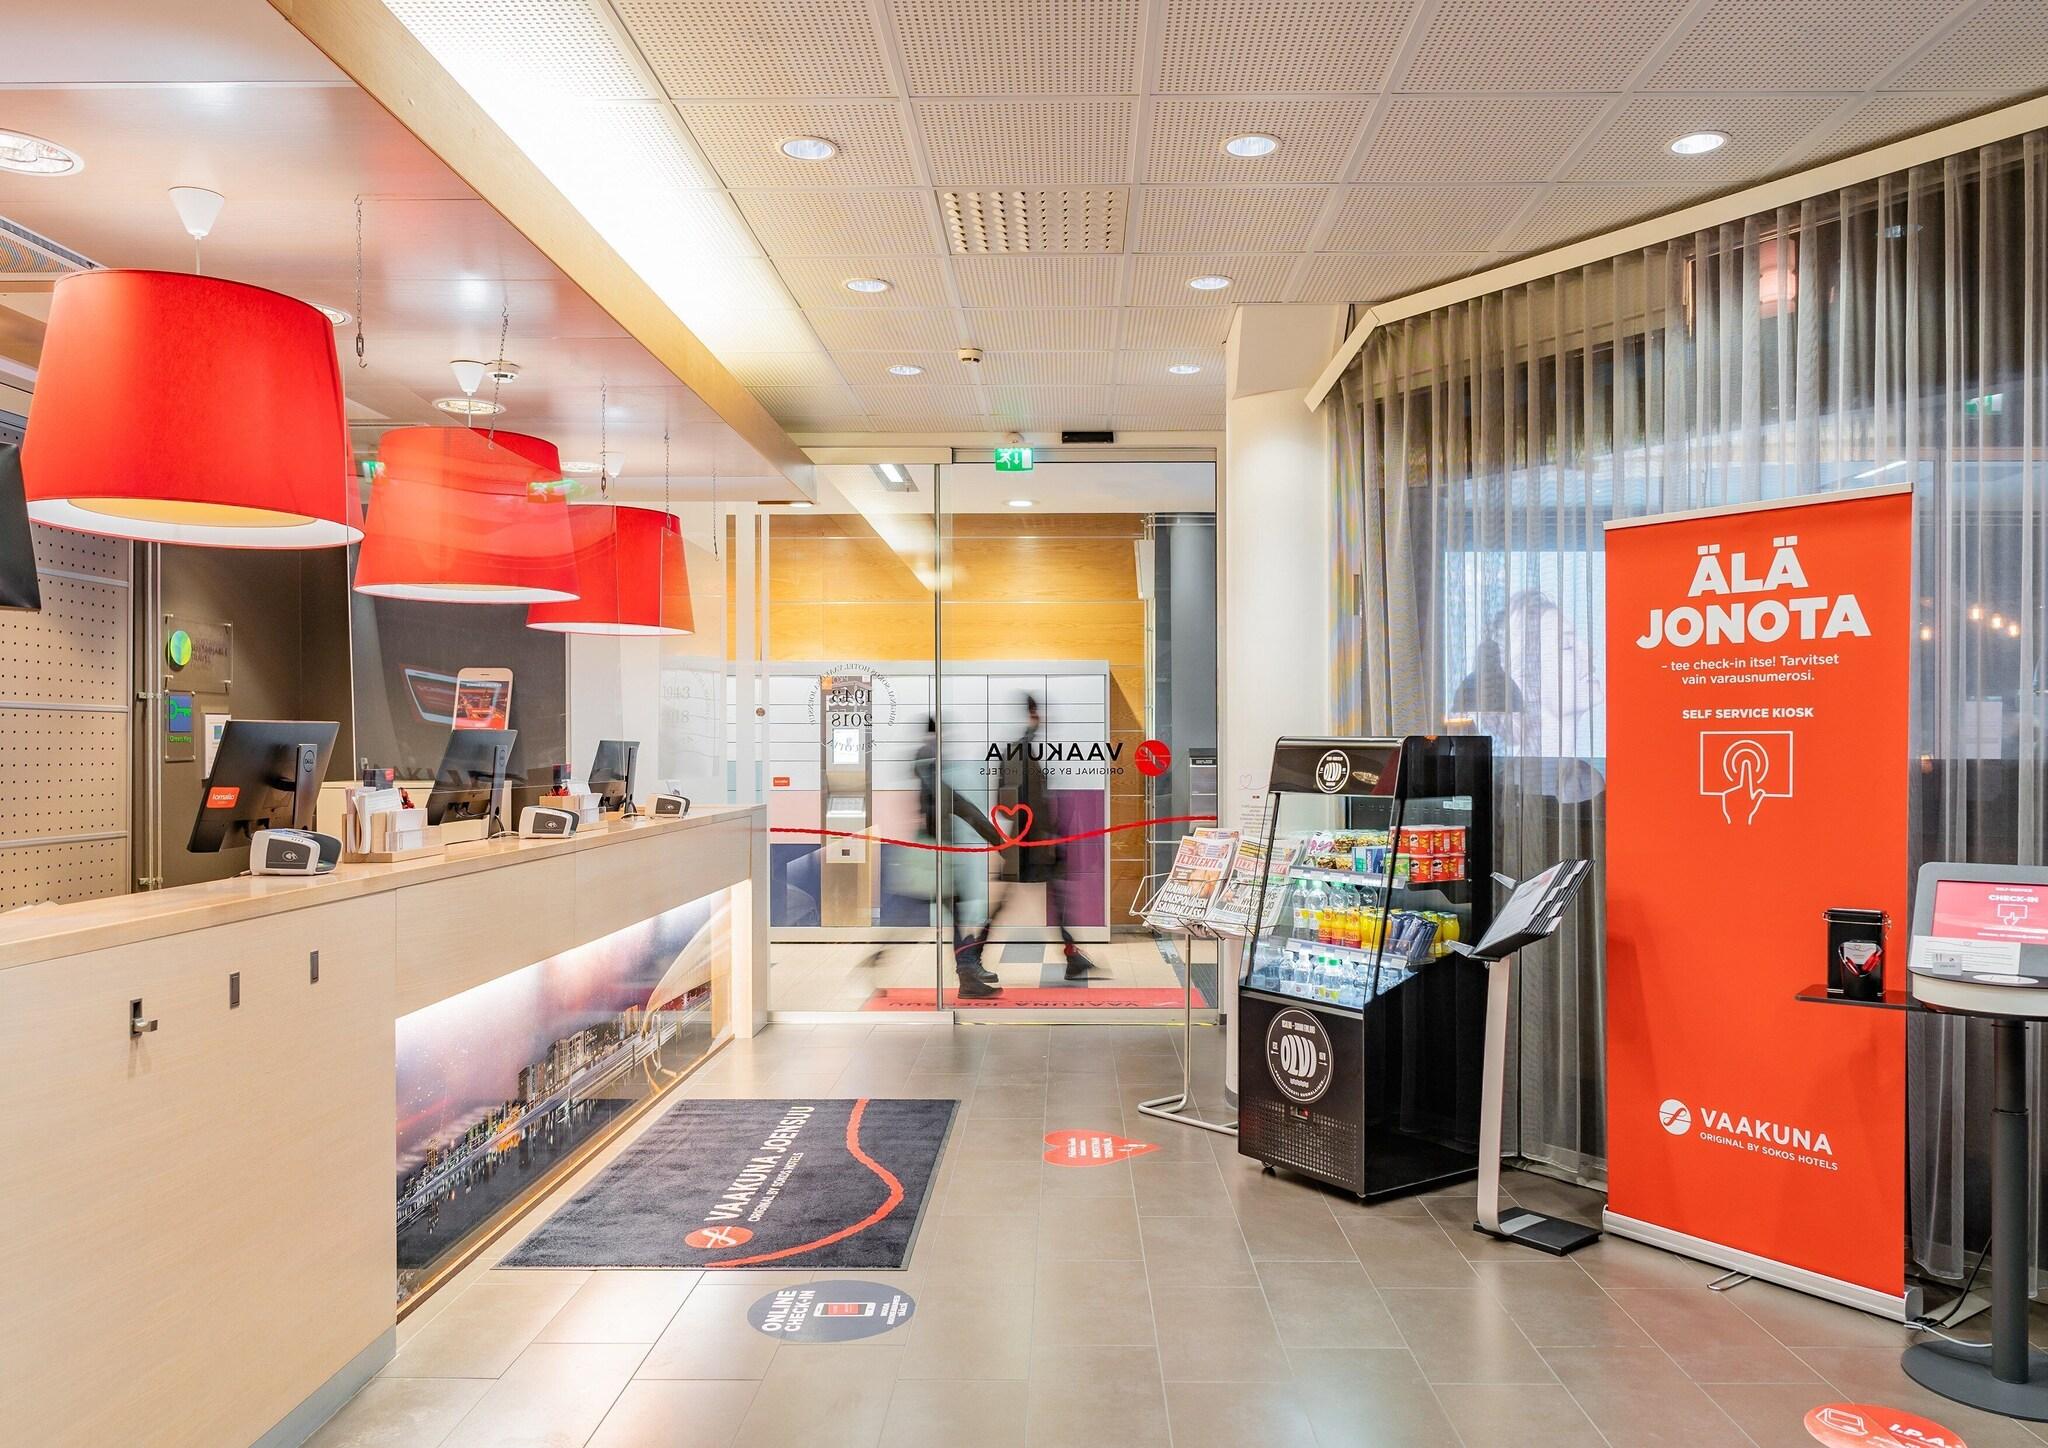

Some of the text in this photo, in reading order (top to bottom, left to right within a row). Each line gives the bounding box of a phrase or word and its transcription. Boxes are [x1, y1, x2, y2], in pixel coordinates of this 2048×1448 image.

[1687, 535, 1809, 597] ÄLÄ
[1635, 594, 1872, 649] JONOTA
[1670, 660, 1690, 671] tee
[1693, 657, 1746, 670] check-in
[1750, 656, 1776, 668] itse!
[1780, 653, 1840, 666] Tarvitset
[1681, 669, 1815, 685] vain varausnumerosi.
[1682, 707, 1814, 719] SELF SERVICE KIOSK
[1988, 894, 2039, 903] CHECK-IN
[1280, 1034, 1317, 1078] OLVI
[1700, 1107, 1833, 1156] VAAKUNA
[1700, 1131, 1839, 1171] ORIGINAL BY SOKOS HOTELS
[704, 1106, 815, 1221] VAAKUNA JOENSUU
[762, 1290, 798, 1331] ONLINE
[784, 1290, 816, 1332] CHECK-IN
